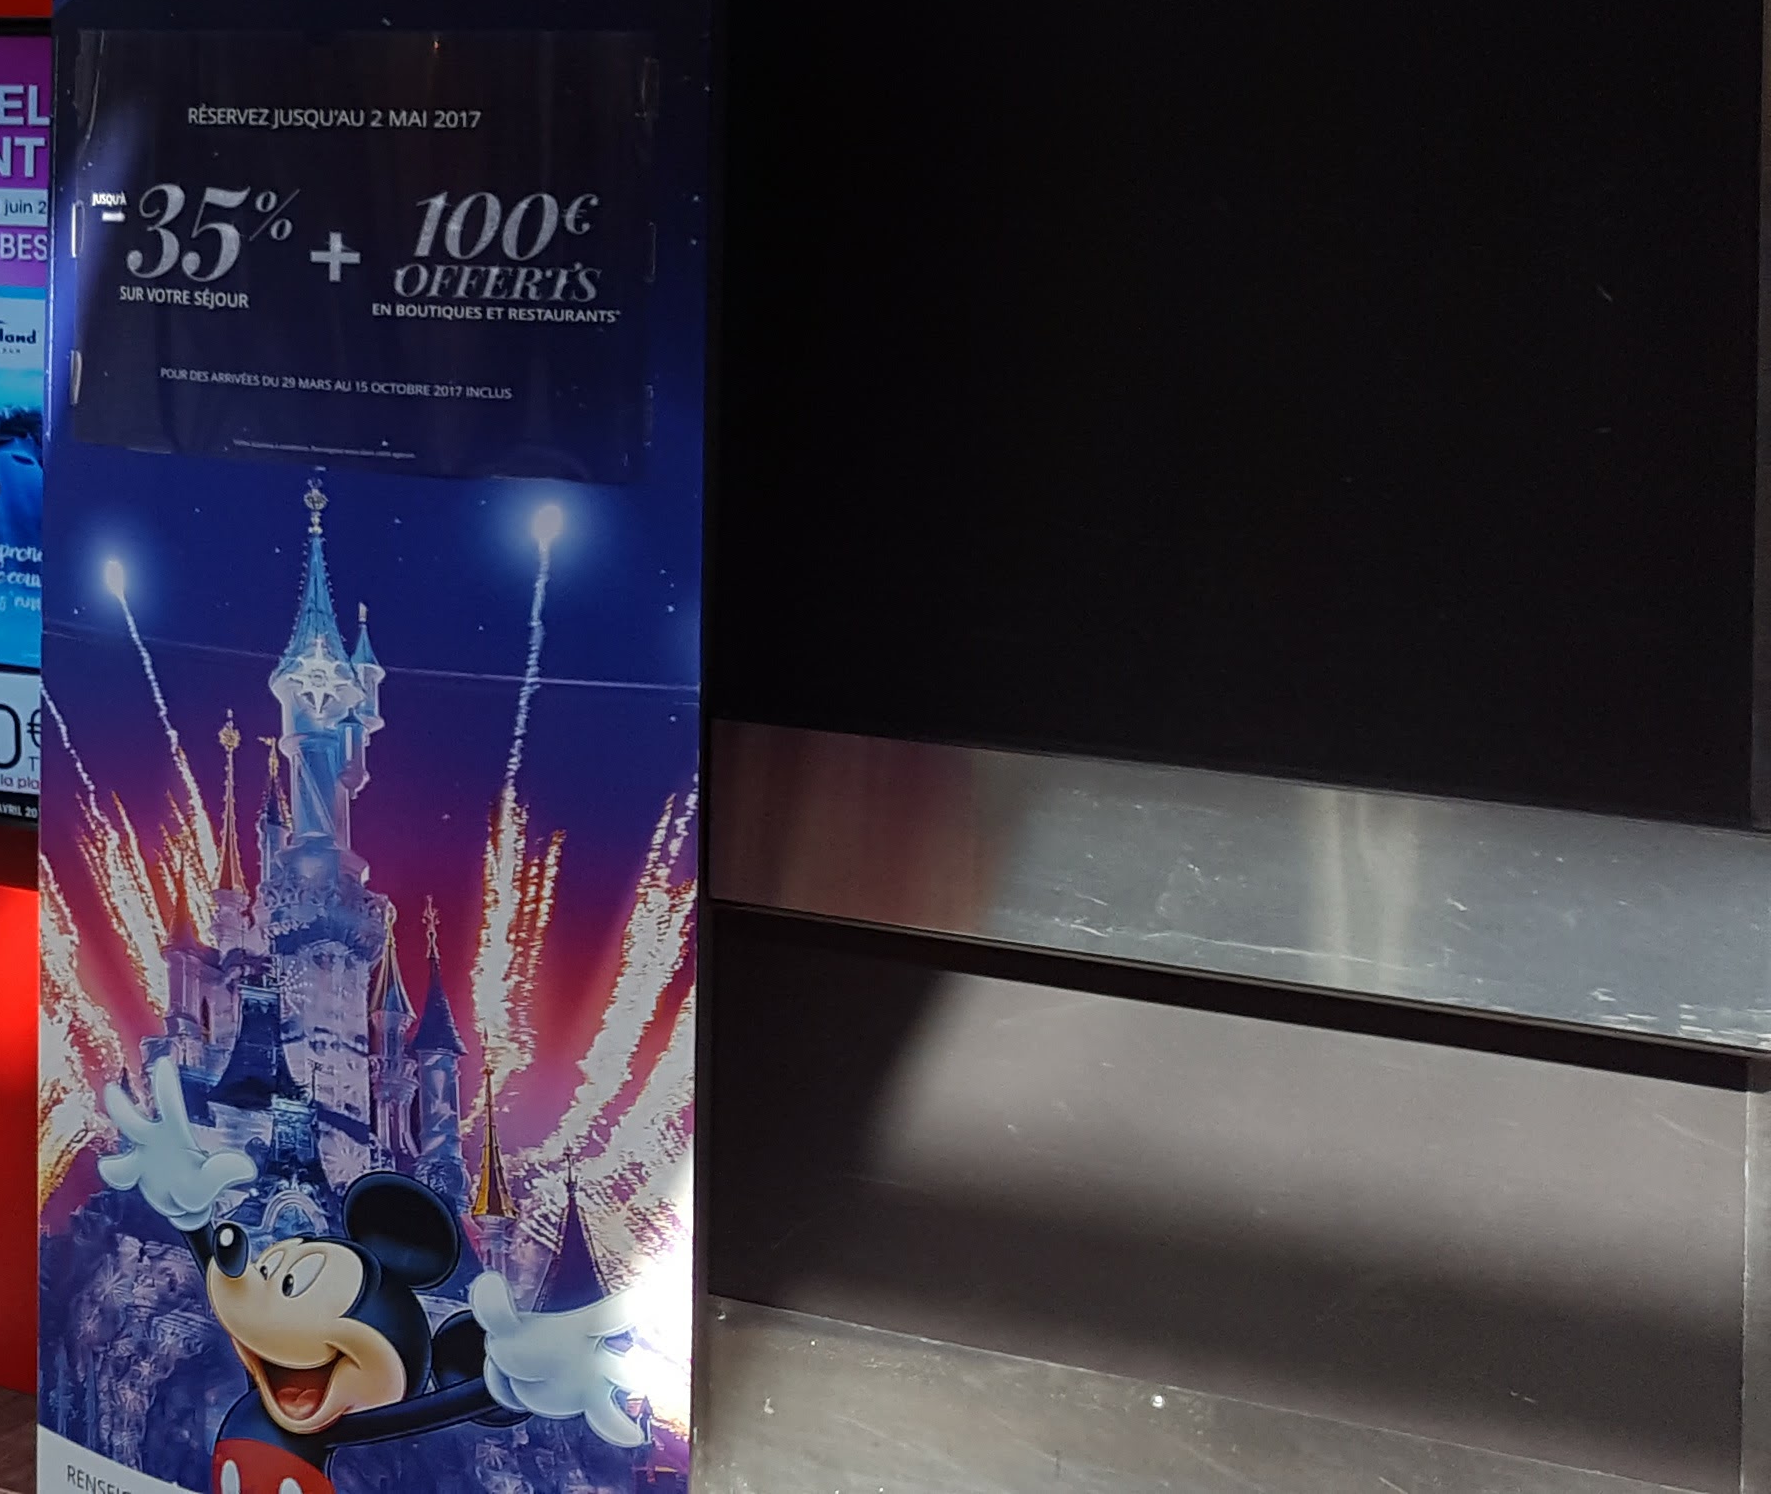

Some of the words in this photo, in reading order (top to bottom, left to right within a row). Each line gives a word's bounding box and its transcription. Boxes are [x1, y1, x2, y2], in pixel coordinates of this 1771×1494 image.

[188, 103, 269, 127] RÉSERVEZ
[272, 107, 365, 131] JUSQU'AU
[370, 109, 382, 128] 2
[388, 110, 427, 128] MAI
[434, 110, 481, 129] 2017
[4, 198, 33, 216] juin
[92, 190, 127, 207] JUSQU'À
[412, 190, 599, 261] 100€
[393, 261, 602, 303] OFFERTS
[119, 285, 144, 301] SUR
[147, 286, 191, 304] VOTRE
[194, 285, 250, 309] SÉJOUR
[372, 303, 391, 317] EN
[395, 304, 482, 322] BOUTIQUES
[486, 307, 503, 321] ET
[160, 366, 188, 381] POUR
[189, 369, 209, 382] DES
[211, 369, 261, 387] ARRIVÉES
[262, 375, 279, 388] DU
[282, 376, 297, 389] 29
[298, 377, 332, 392] MARS
[334, 379, 352, 393] AU
[355, 380, 369, 393] 15
[371, 381, 431, 397] OCTOBRE
[433, 383, 462, 398] 2017
[465, 384, 512, 400] INCLUS
[67, 1464, 132, 1494] RENSE
